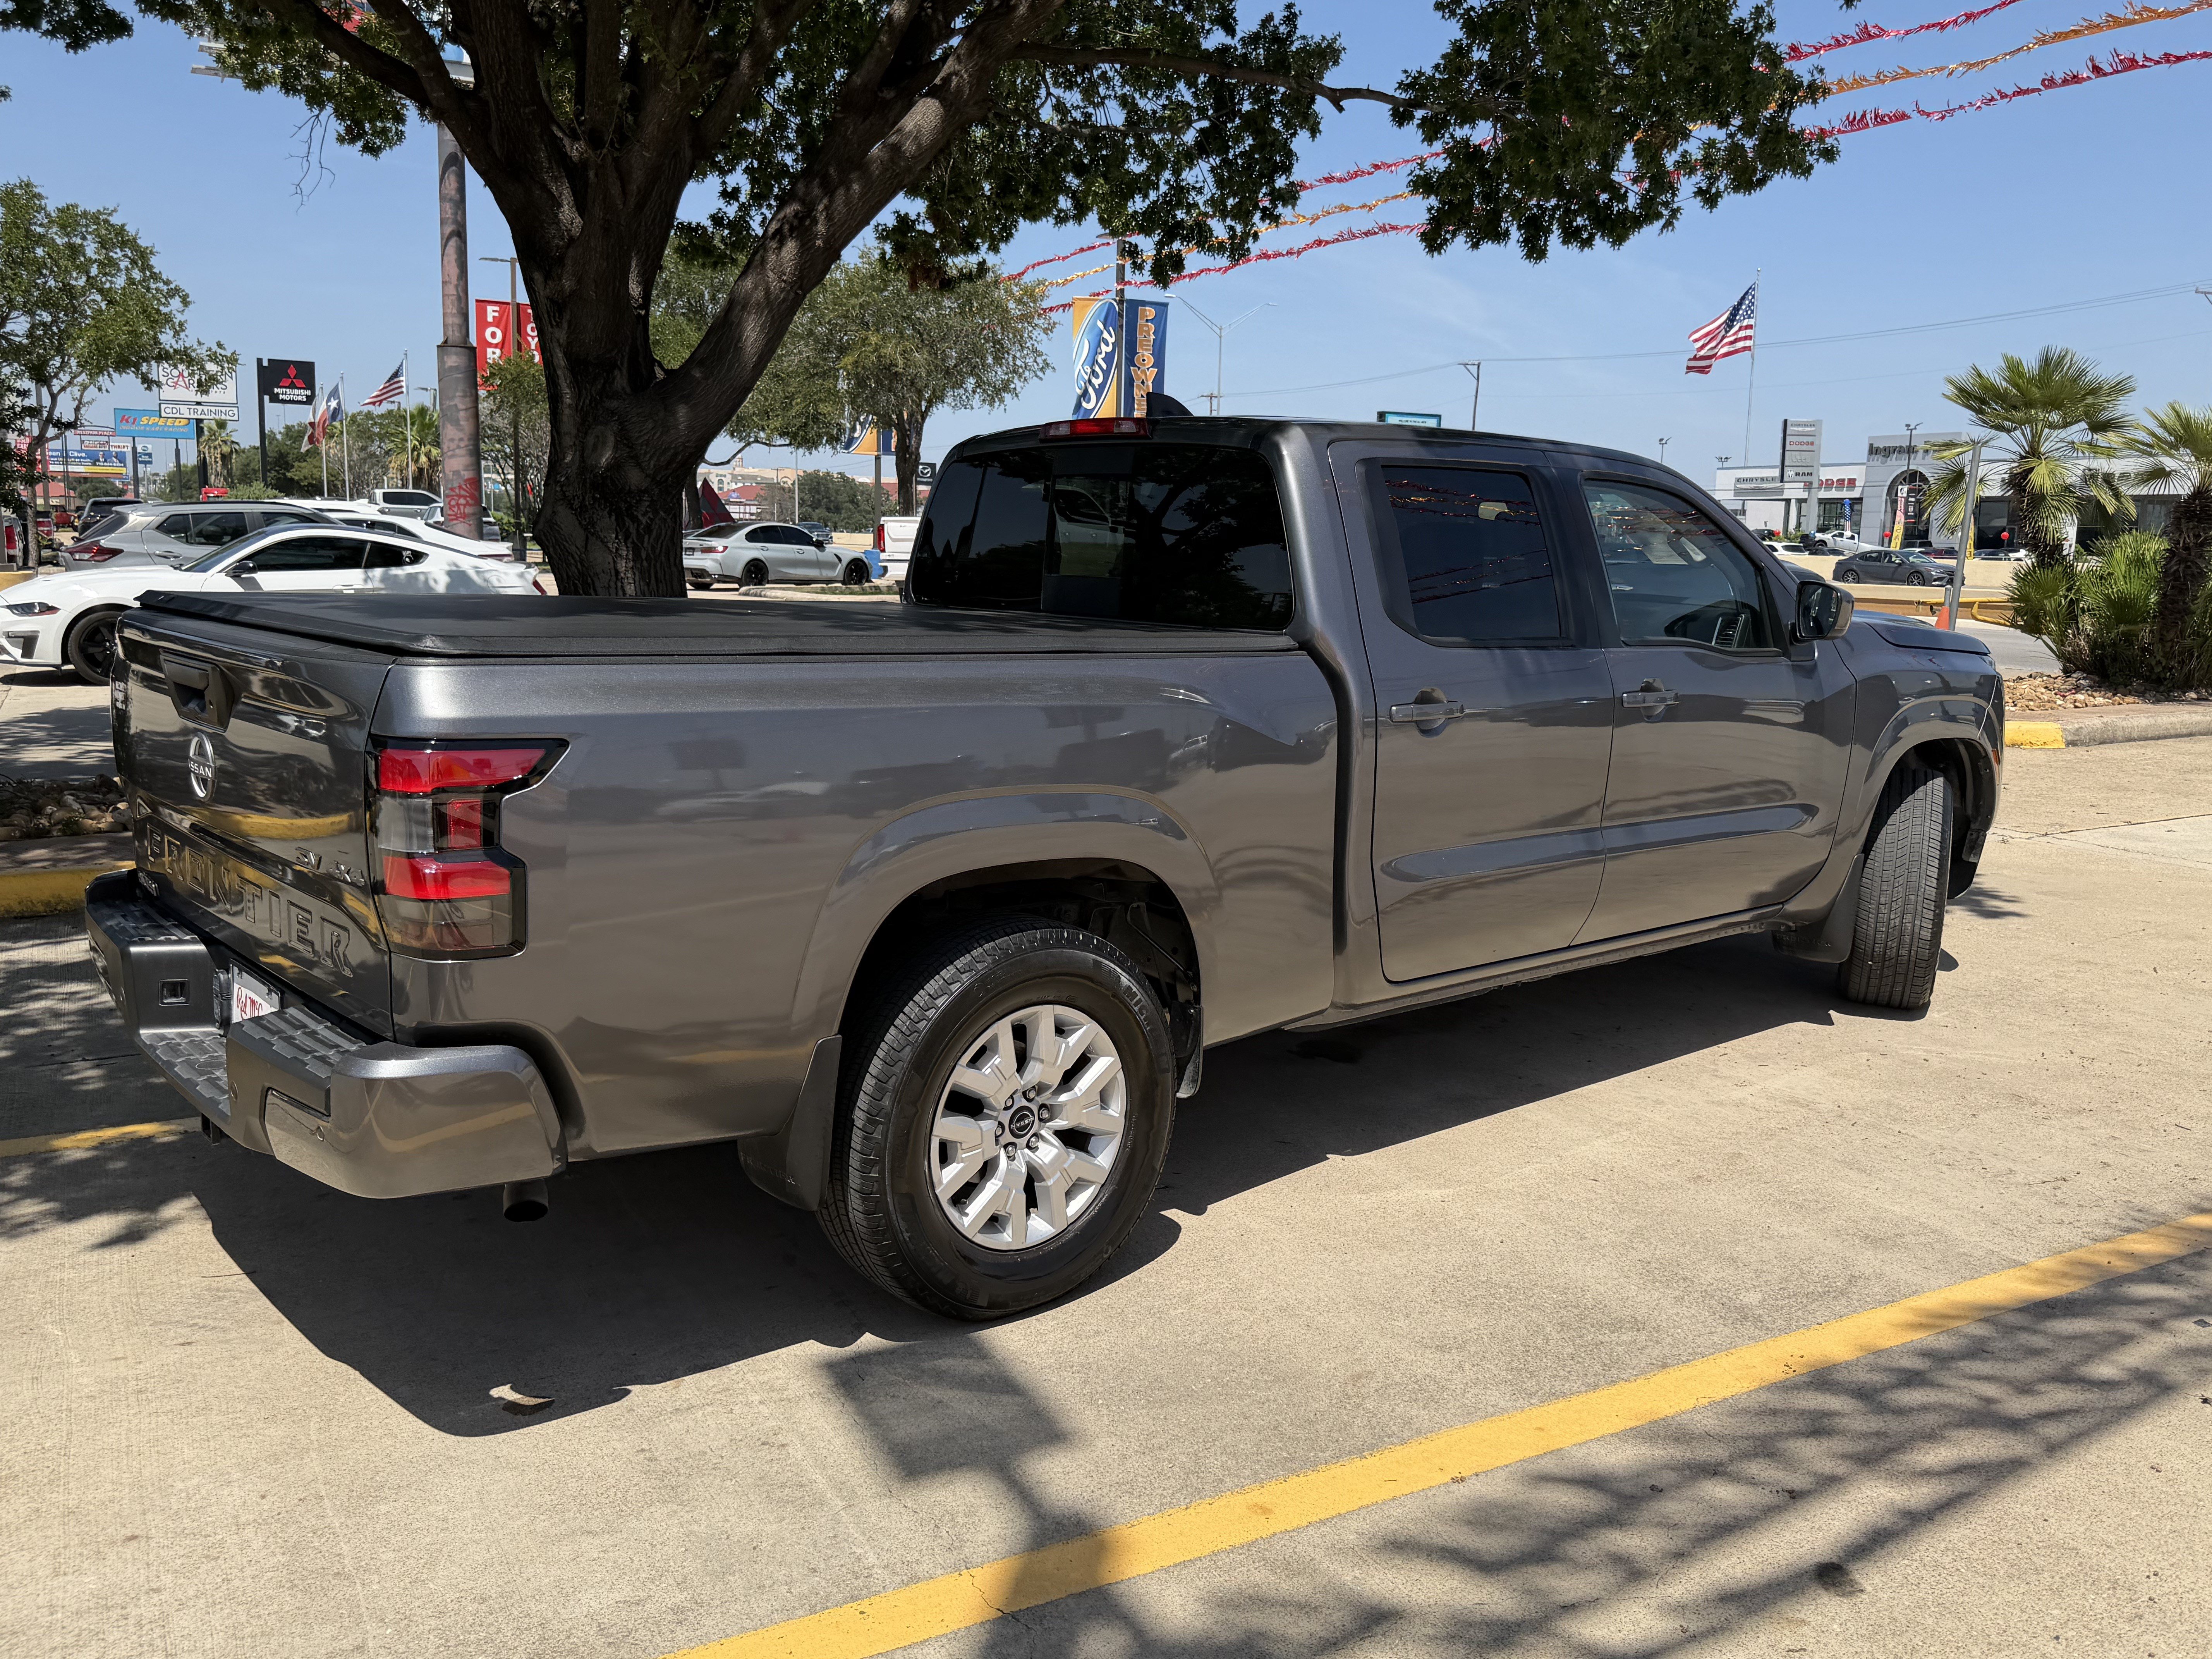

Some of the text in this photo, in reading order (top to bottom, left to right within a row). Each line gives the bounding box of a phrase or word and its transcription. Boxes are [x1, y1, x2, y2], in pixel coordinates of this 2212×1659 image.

[485, 305, 503, 376] FOR
[1130, 306, 1158, 418] PREOWNE
[1075, 319, 1115, 410] Ford
[164, 407, 235, 417] CDL TRAINING
[274, 388, 311, 396] MITSUBISHI
[140, 416, 190, 426] SPEED
[188, 758, 212, 778] ISSAN
[147, 822, 353, 978] FRONTIER
